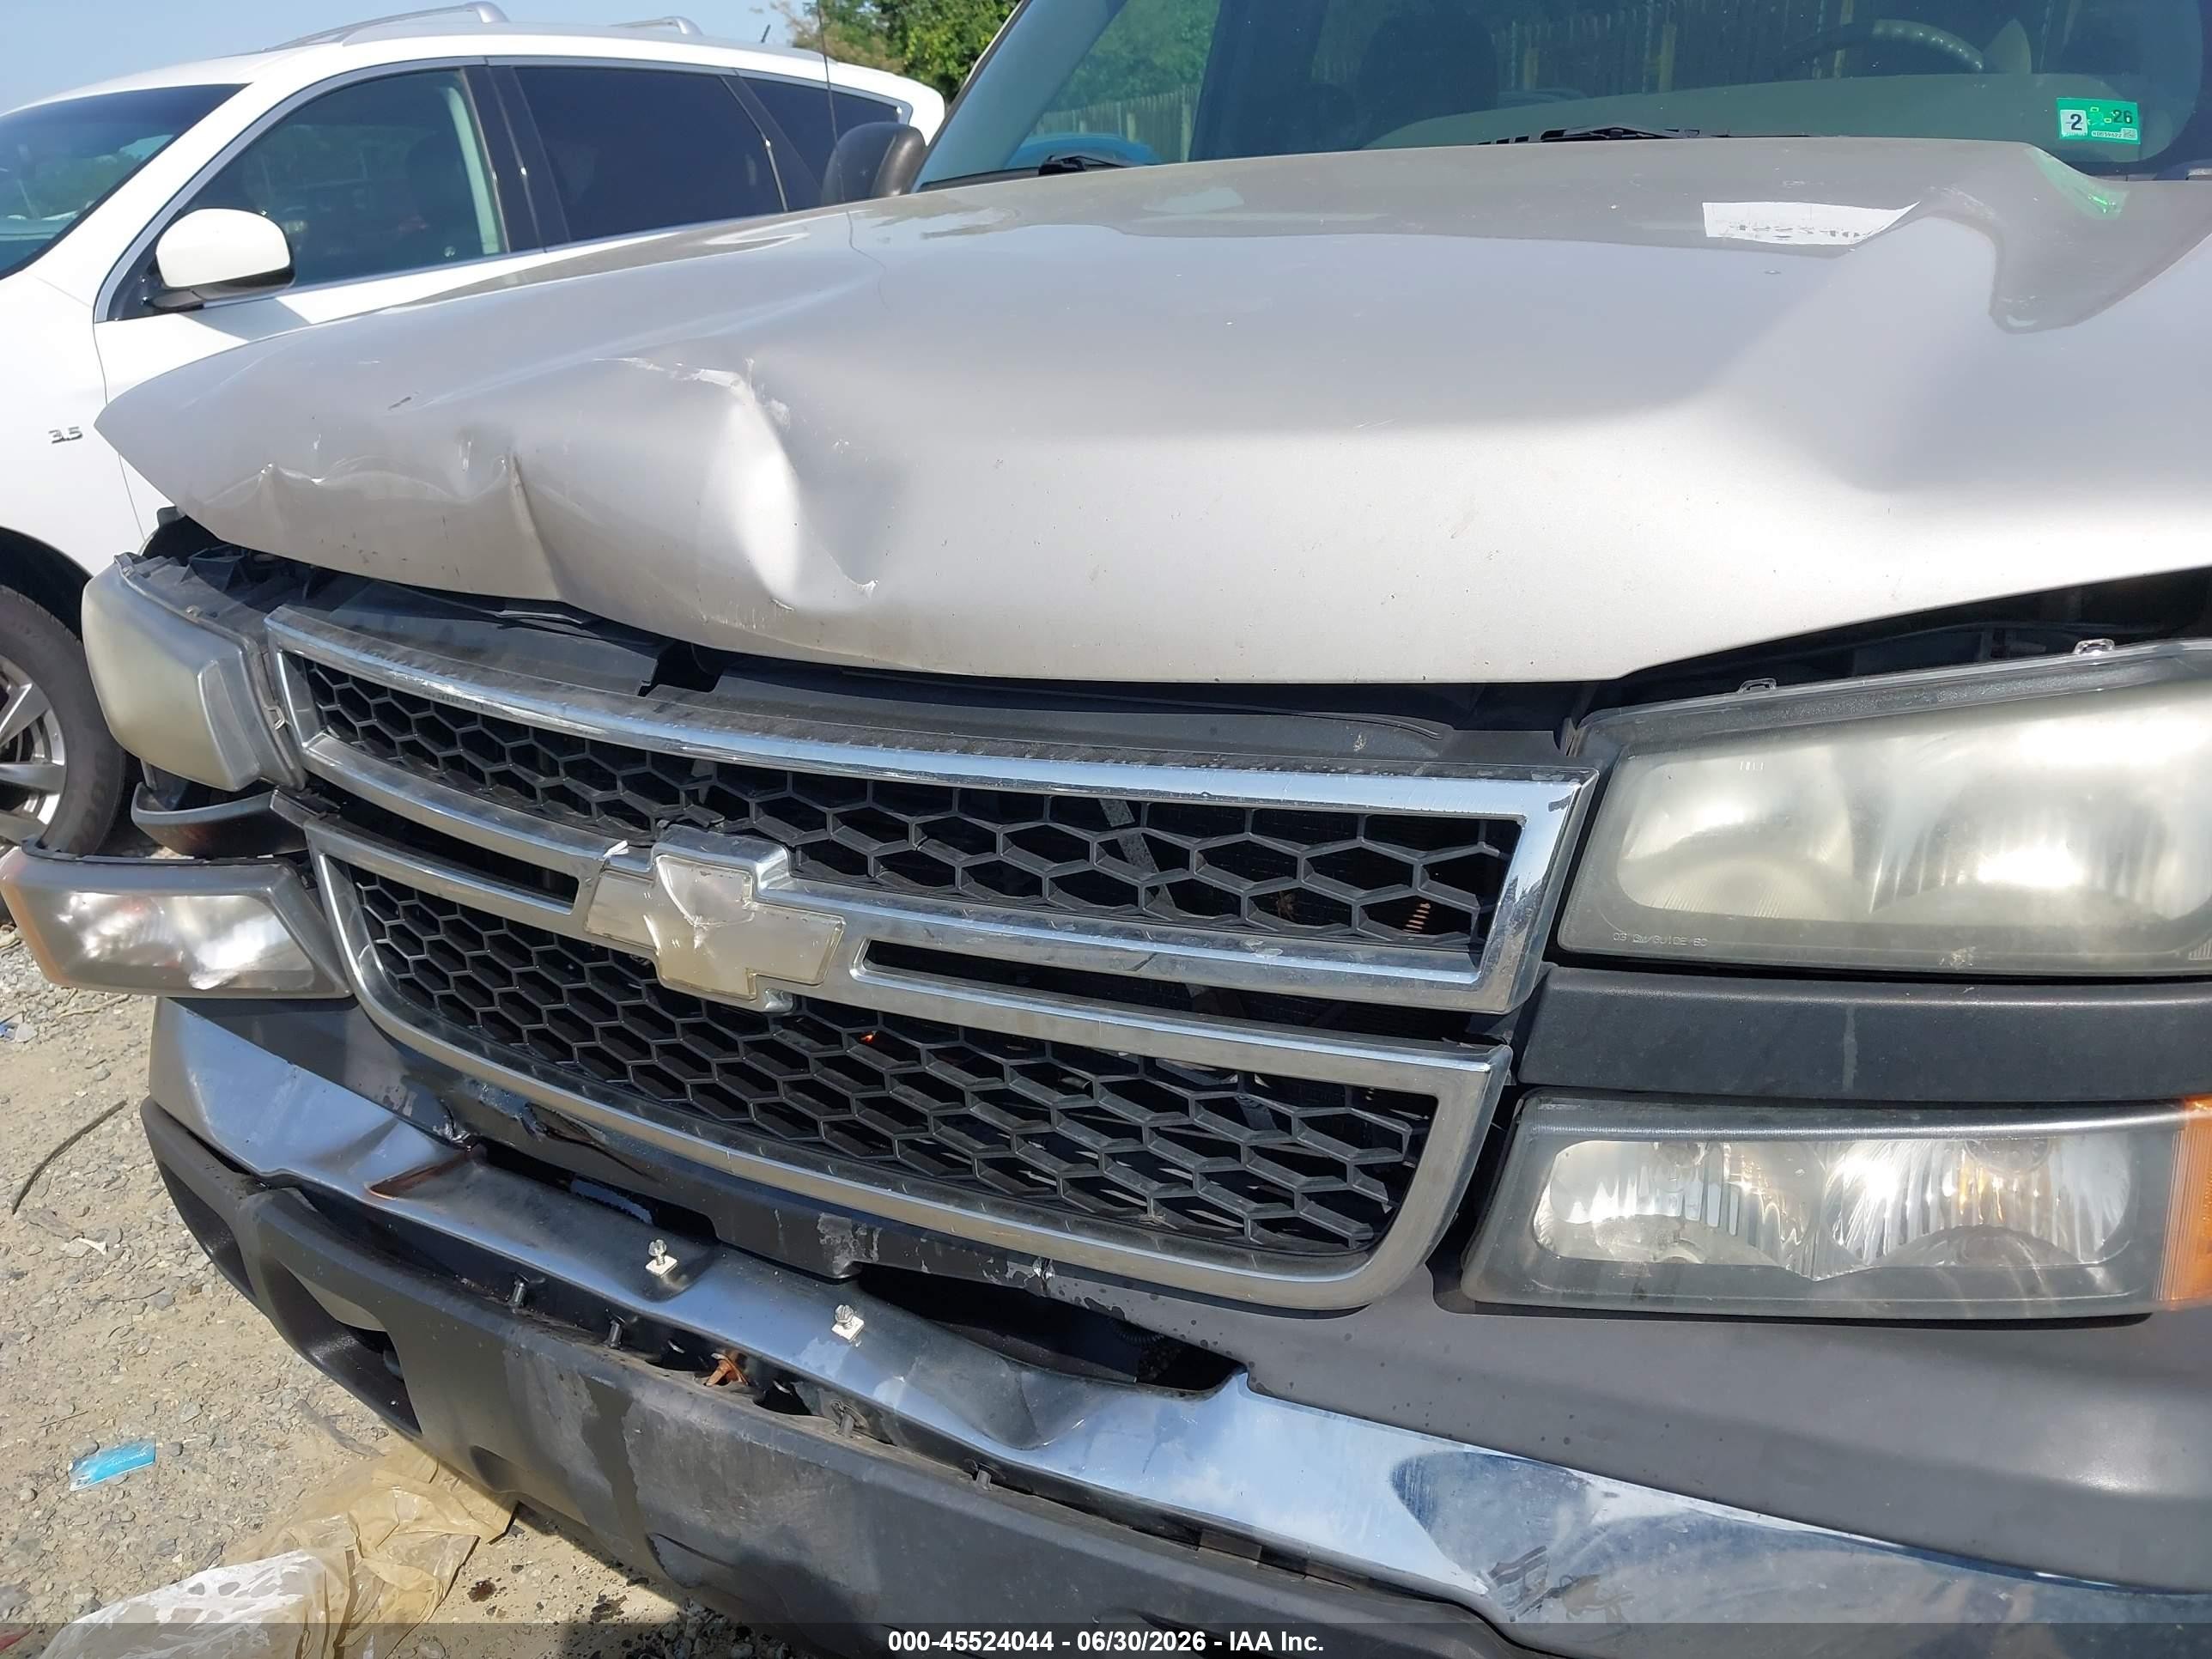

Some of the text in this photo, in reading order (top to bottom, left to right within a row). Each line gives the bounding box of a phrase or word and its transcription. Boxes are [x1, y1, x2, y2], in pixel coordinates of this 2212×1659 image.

[2069, 109, 2134, 131] 2 26
[48, 426, 82, 444] 3.5
